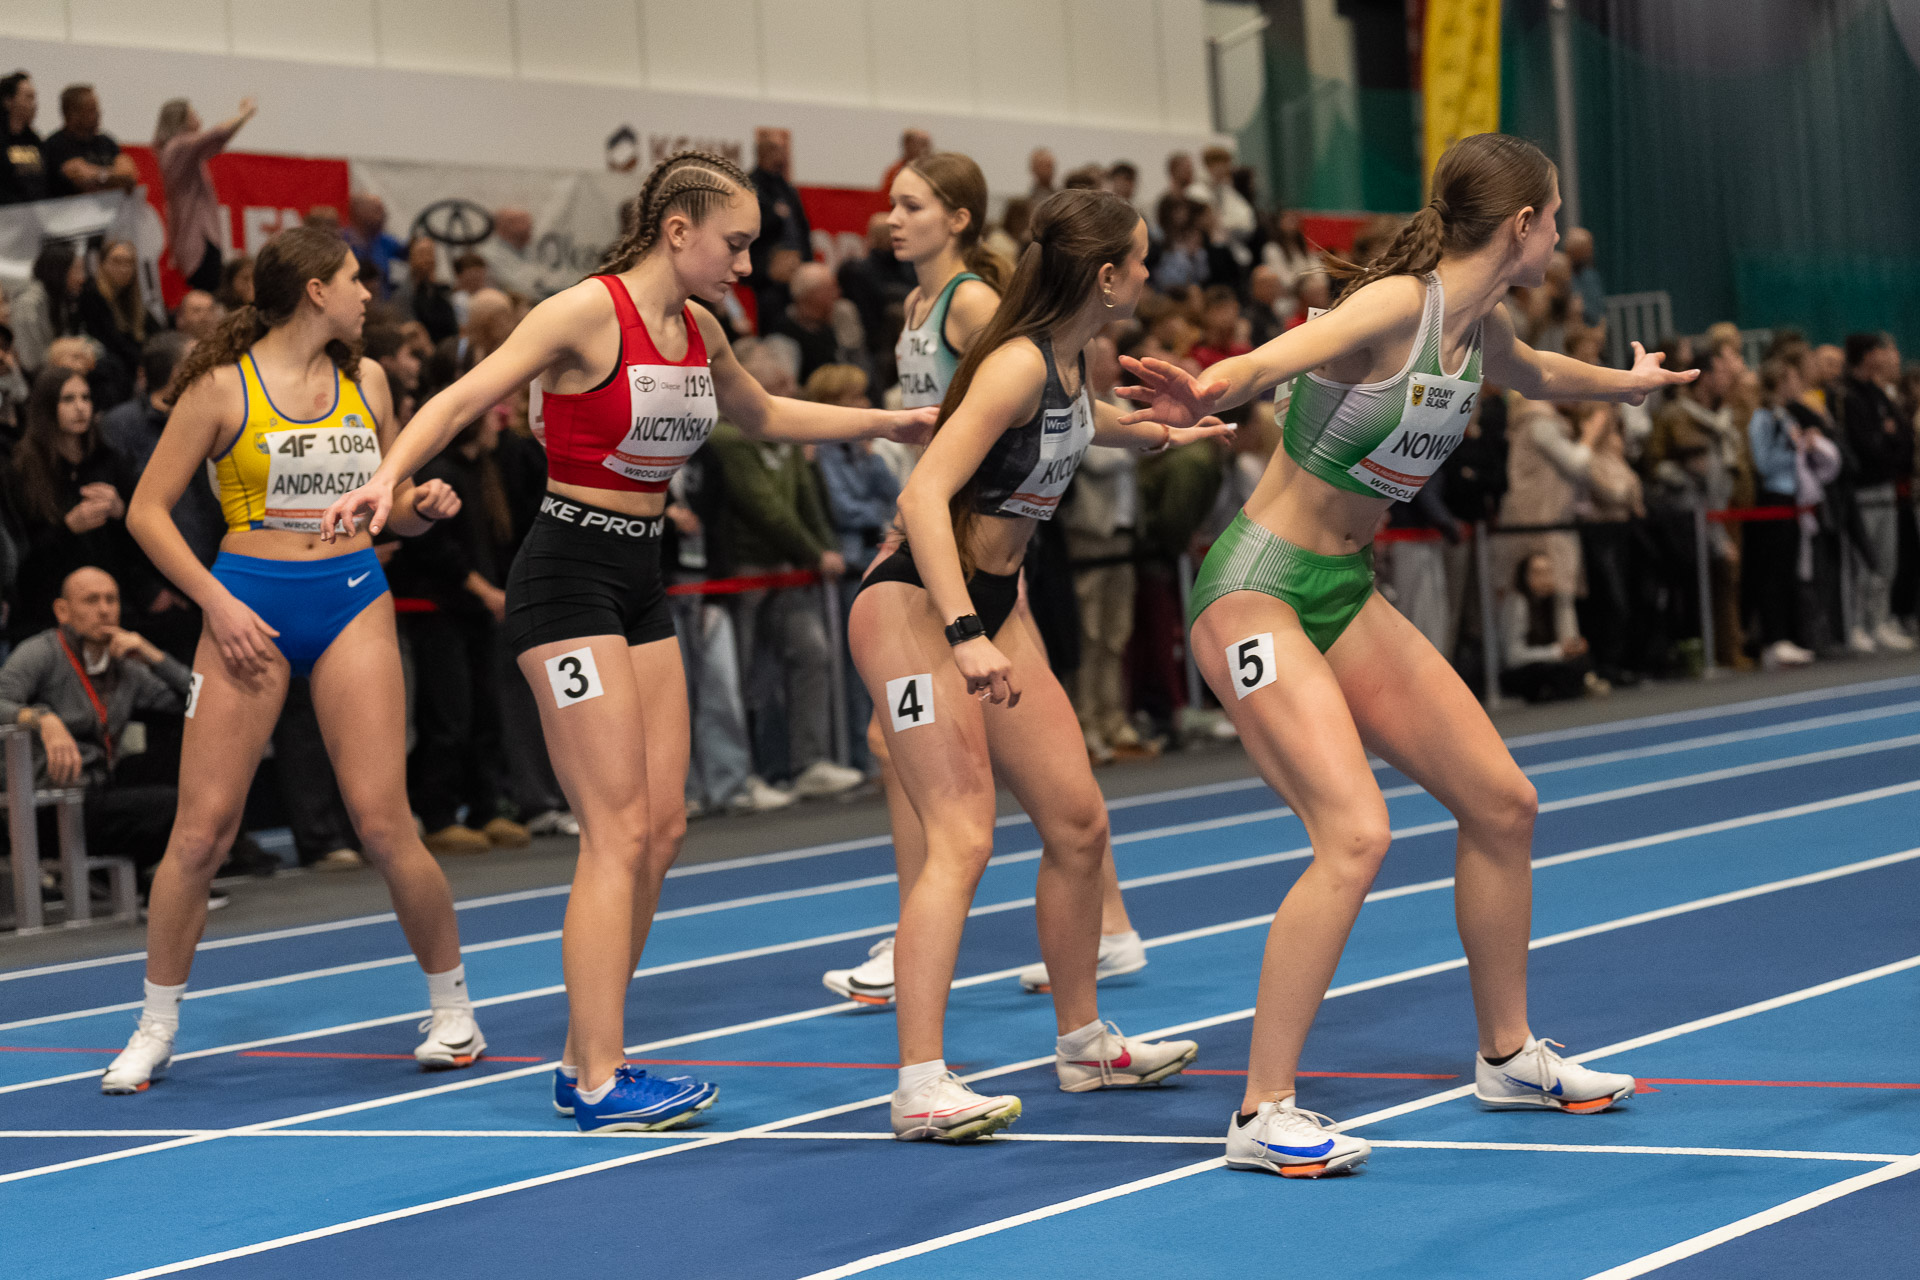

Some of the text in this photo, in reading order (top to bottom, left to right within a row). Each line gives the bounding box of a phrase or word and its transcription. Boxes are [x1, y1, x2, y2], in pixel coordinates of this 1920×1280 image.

[684, 375, 714, 398] 1191
[1428, 386, 1456, 399] DOLNY
[1460, 392, 1476, 415] 6
[630, 412, 713, 442] KUCZYŃSKA
[278, 433, 376, 458] 4F 1084
[580, 511, 646, 537] PRO
[1238, 638, 1264, 688] 5
[558, 656, 589, 699] 3
[897, 679, 924, 723] 4
